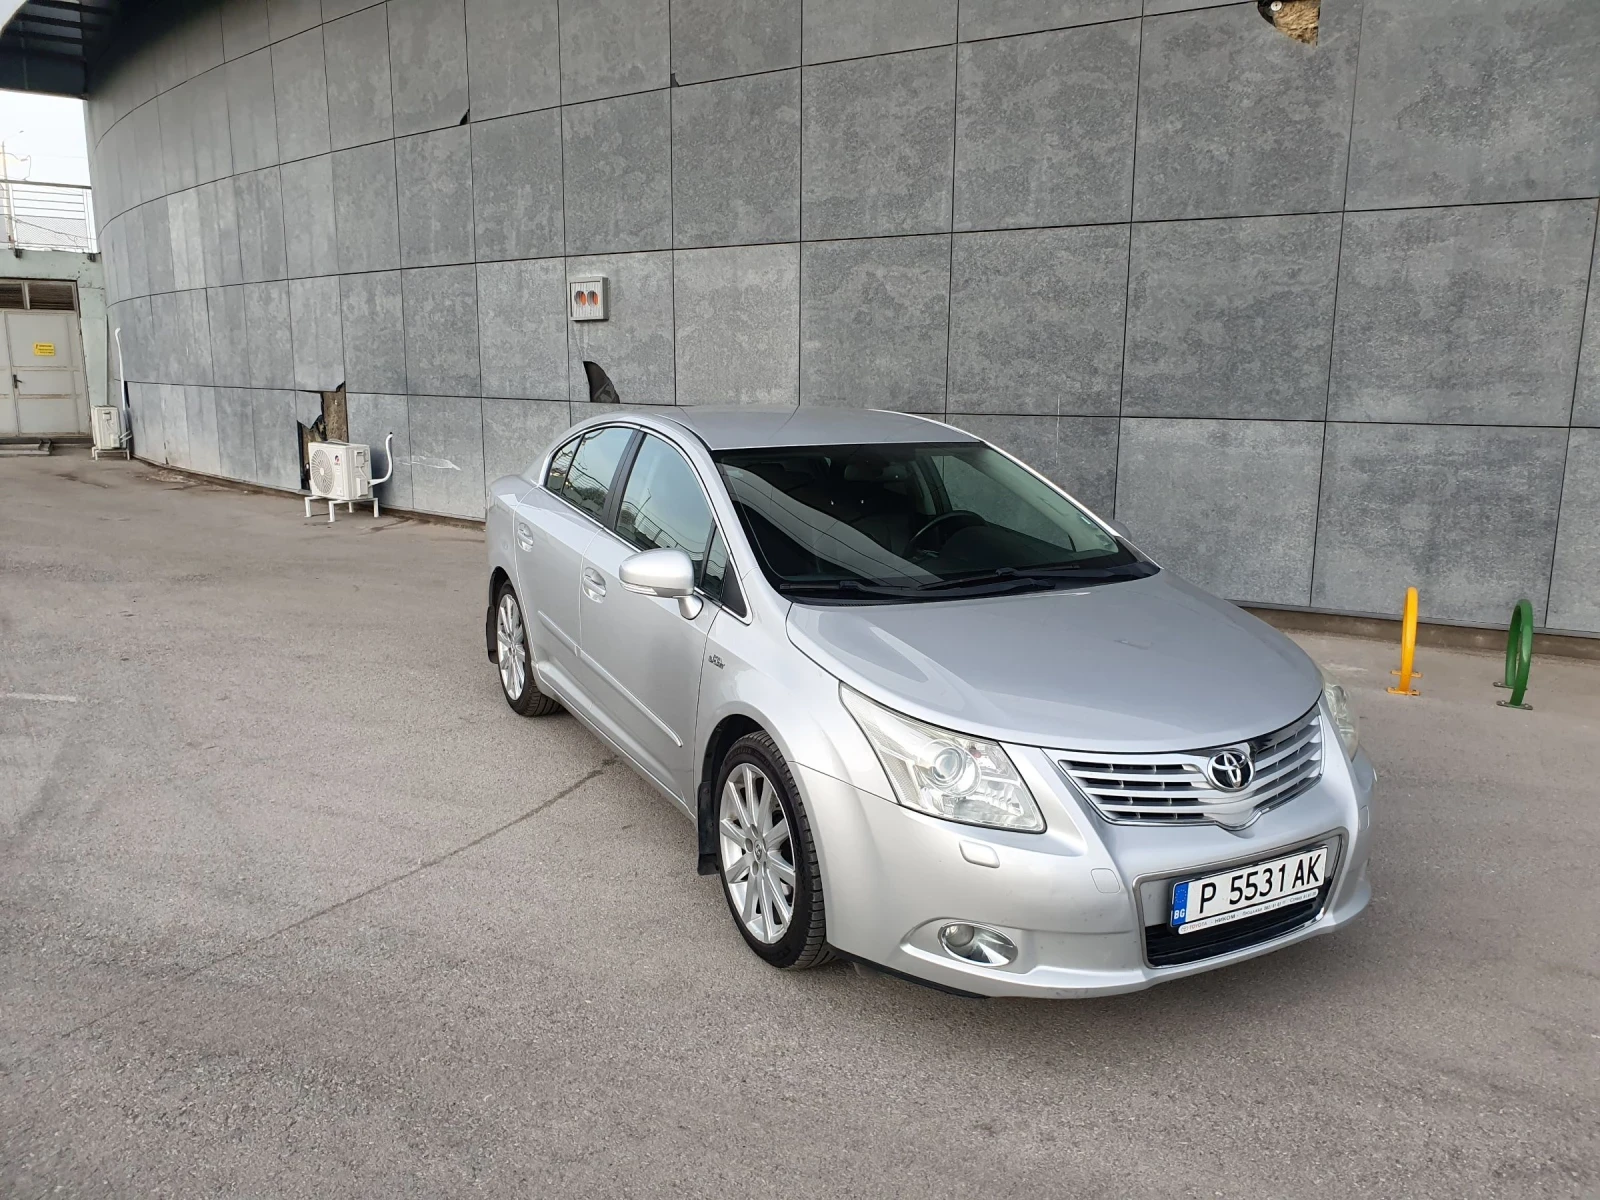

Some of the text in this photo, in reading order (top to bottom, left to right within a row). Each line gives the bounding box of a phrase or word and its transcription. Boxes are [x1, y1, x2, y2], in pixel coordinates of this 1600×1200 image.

[1199, 853, 1322, 914] P 5531 AK
[1174, 908, 1186, 920] BG
